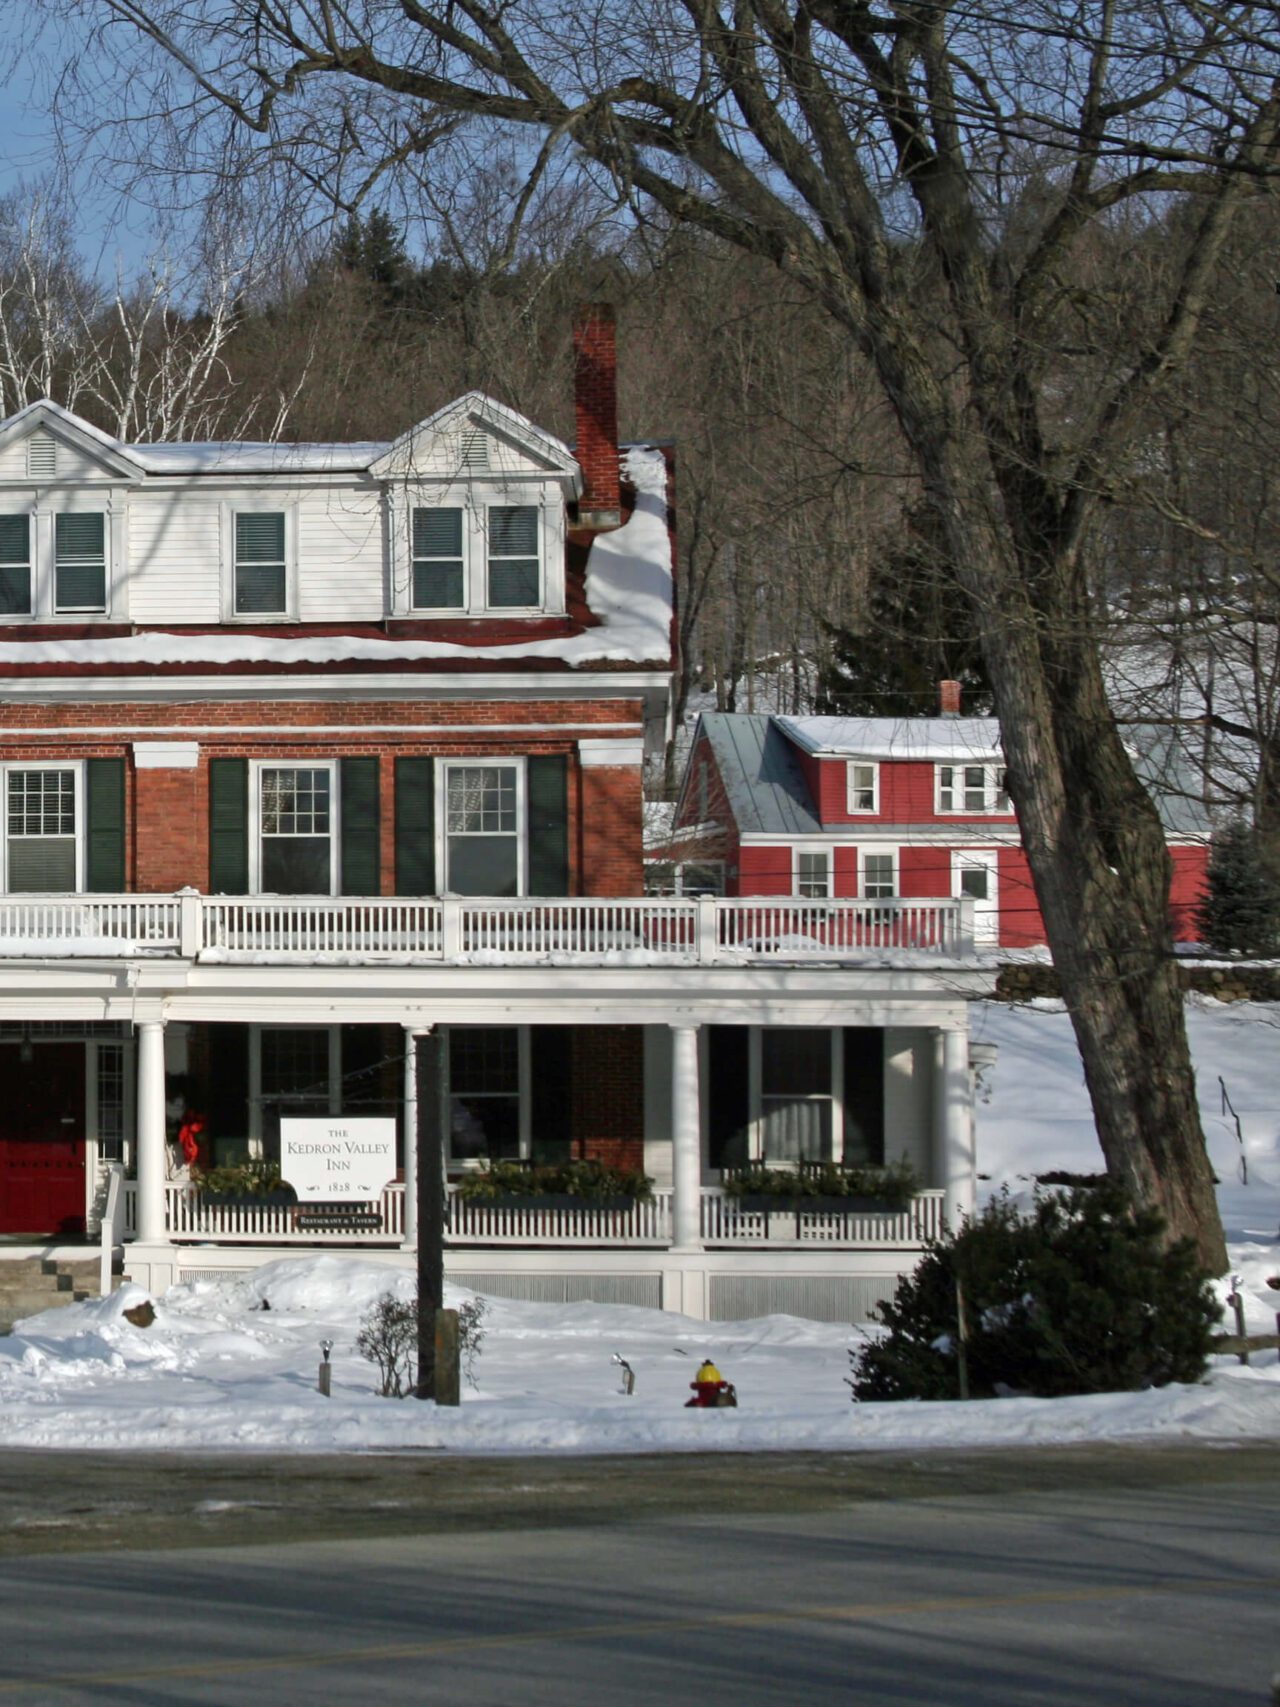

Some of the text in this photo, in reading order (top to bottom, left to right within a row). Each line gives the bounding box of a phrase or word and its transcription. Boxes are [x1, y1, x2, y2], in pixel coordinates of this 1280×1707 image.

[328, 1130, 349, 1138] THE
[287, 1142, 389, 1154] KEDRON VALLEY
[327, 1159, 351, 1171] INN
[328, 1183, 350, 1192] 1828
